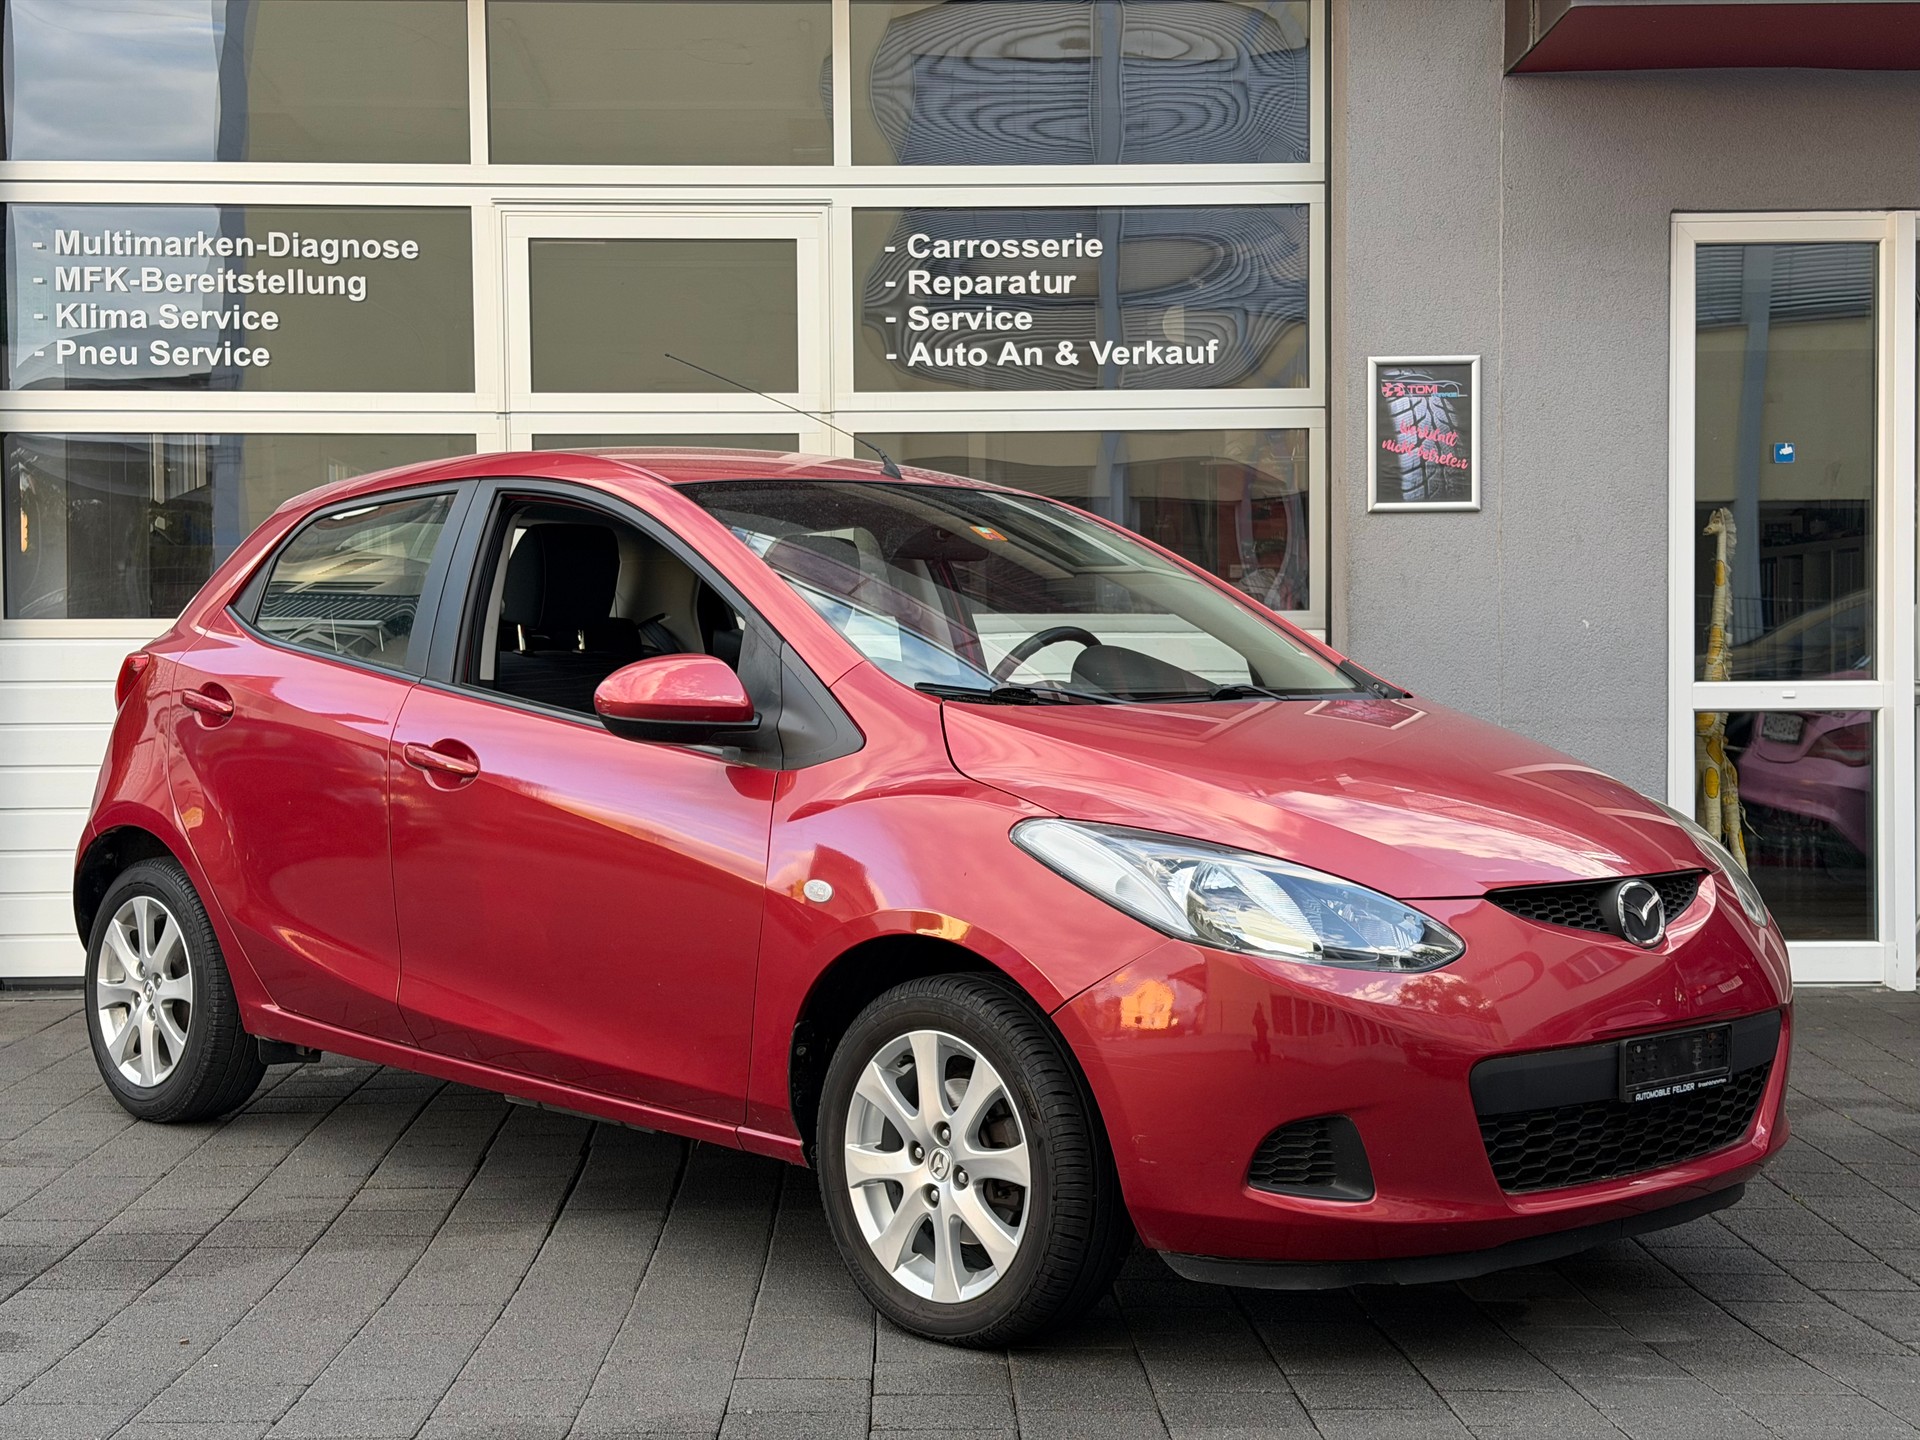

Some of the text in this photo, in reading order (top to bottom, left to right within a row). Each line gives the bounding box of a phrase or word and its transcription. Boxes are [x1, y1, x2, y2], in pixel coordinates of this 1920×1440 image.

[55, 229, 419, 267] Multimarken-Diagnose
[907, 233, 1103, 258] Carrosserie
[55, 266, 366, 302] MFK-Bereitstellung
[908, 270, 1077, 301] Reparatur
[55, 302, 147, 329] Klima
[158, 303, 279, 330] Service
[908, 305, 1033, 331] Service
[56, 339, 138, 366] Pneu
[149, 340, 270, 367] Service
[907, 341, 988, 367] Auto
[997, 341, 1043, 366] An
[1055, 340, 1079, 366] &
[1089, 339, 1219, 365] Verkauf
[1408, 385, 1439, 395] TOMI
[1417, 445, 1468, 470] betreten
[1635, 1087, 1671, 1102] AUTOMOBILE
[1672, 1082, 1695, 1094] FELDER
